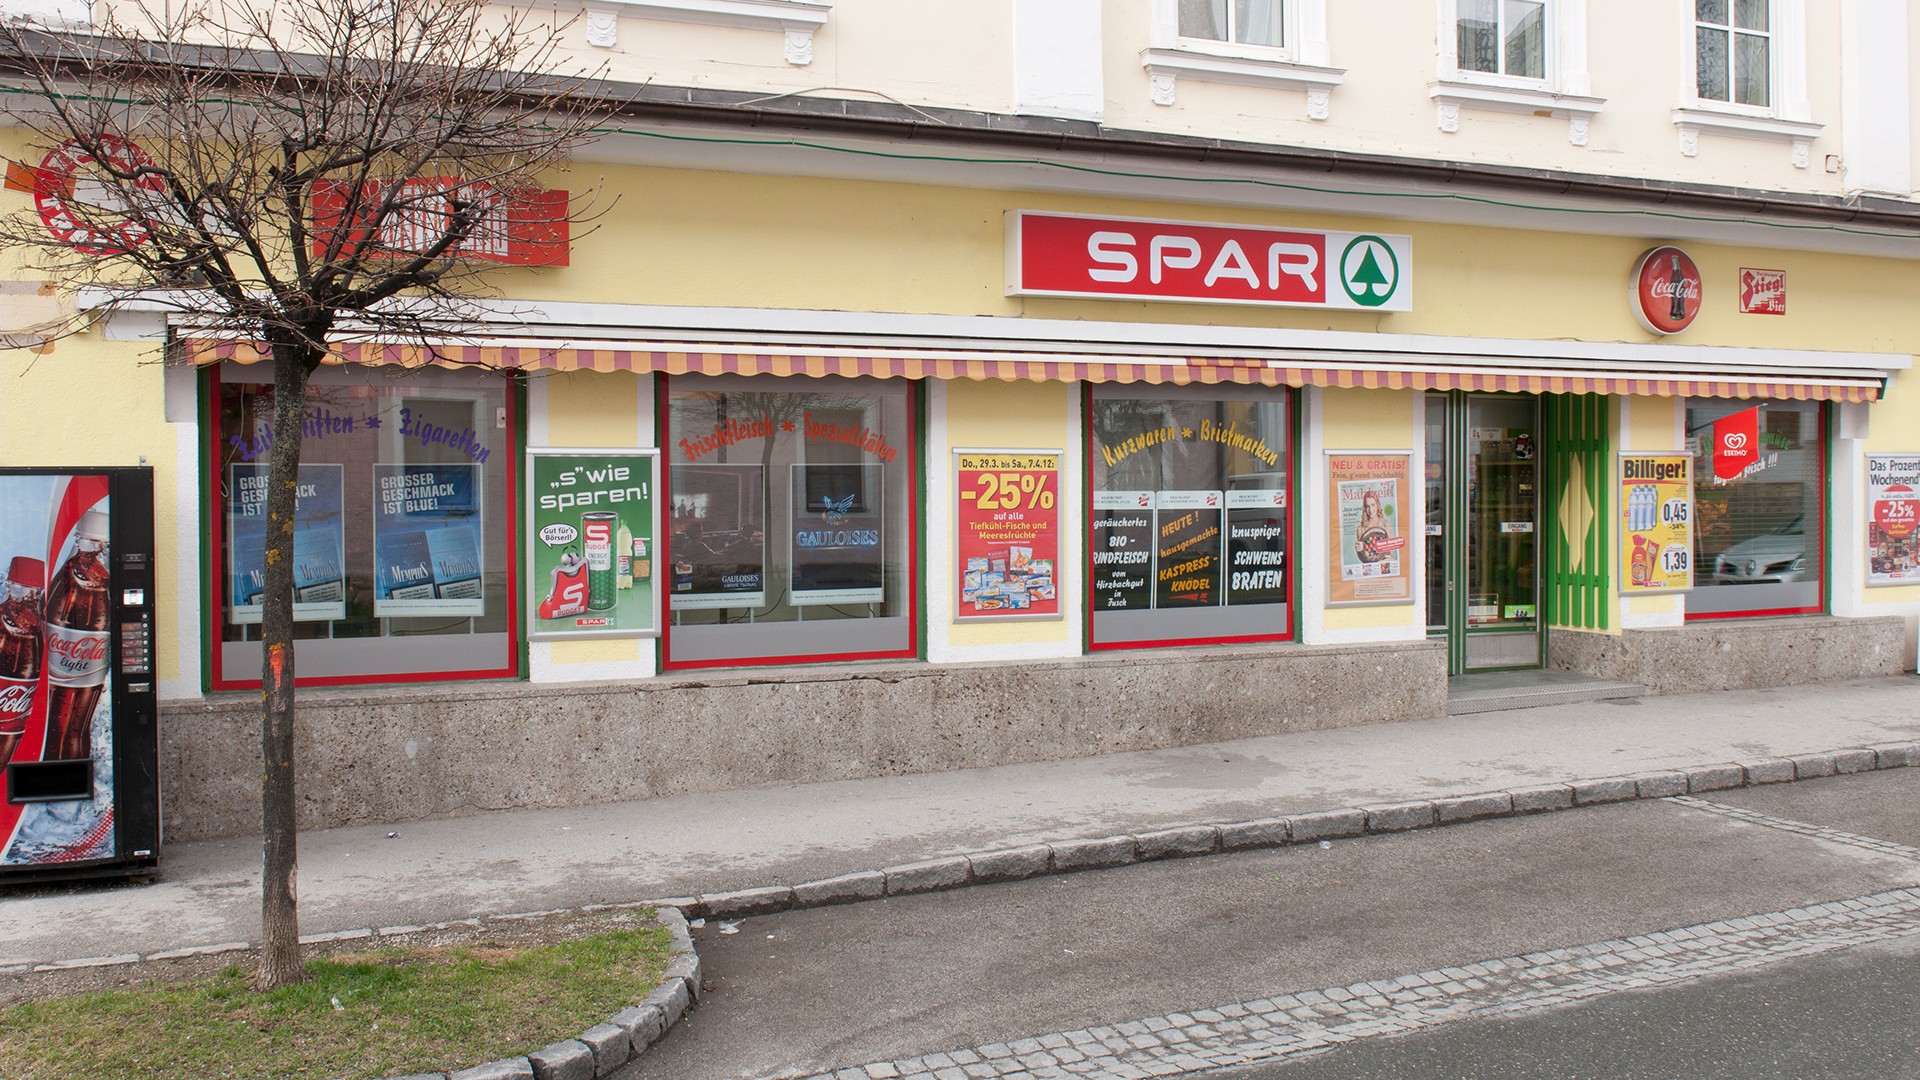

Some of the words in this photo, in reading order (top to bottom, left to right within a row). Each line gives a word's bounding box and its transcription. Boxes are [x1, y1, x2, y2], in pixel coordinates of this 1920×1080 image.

[1087, 231, 1318, 292] SPAR
[1651, 277, 1699, 299] Coca-Cola
[1742, 271, 1784, 311] Stiegl
[1768, 300, 1785, 312] Bier
[230, 406, 353, 460] Zeitriften
[399, 408, 491, 464] Zigaretten
[679, 413, 774, 462] Frischfleisch
[804, 412, 897, 463] Spezialitäten
[1102, 427, 1175, 467] Kurzwaren
[1200, 419, 1278, 465] Briefmarken
[587, 464, 630, 483] wie
[962, 460, 978, 470] Do.,
[980, 460, 999, 468] 29.3.
[1001, 460, 1011, 468] bis
[1012, 460, 1027, 470] Sa.,
[1028, 460, 1054, 468] 7.4.12:
[1332, 460, 1353, 469] NEU
[1356, 461, 1364, 469] &
[1367, 460, 1405, 469] GRATIS!
[1624, 460, 1686, 480] Billiger!
[1870, 460, 1886, 471] Das
[381, 473, 434, 489] GROSSER
[383, 483, 455, 502] GESCHMACK
[540, 482, 648, 512] sparen!
[961, 473, 1054, 509] -25%
[243, 503, 262, 516] IST
[383, 500, 402, 514] IST
[406, 498, 439, 512] BLUE!
[1663, 503, 1687, 522] 0,45
[1882, 501, 1914, 517] -25%
[1008, 512, 1024, 520] alle
[1093, 517, 1147, 530] geräuchertes
[586, 525, 609, 545] S
[1162, 515, 1193, 537] HEUTE
[1232, 525, 1281, 541] knuspriger
[796, 529, 879, 547] GAULOISES
[1109, 536, 1127, 547] BIO
[1160, 526, 1219, 558] hausgemachte
[1093, 551, 1149, 565] RINDFLEISCH
[1234, 551, 1283, 565] SCHWEINS
[1664, 552, 1687, 571] 1,39
[722, 575, 759, 583] GAULOISES
[1160, 559, 1210, 581] KASPRESS
[1096, 578, 1144, 590] Hirzbachgut
[1171, 578, 1210, 592] KNÖDEL
[1232, 570, 1282, 590] BRATEN
[560, 582, 584, 608] S
[557, 607, 581, 616] BUDGET
[48, 632, 107, 660] Coca-Cola
[60, 656, 89, 671] light
